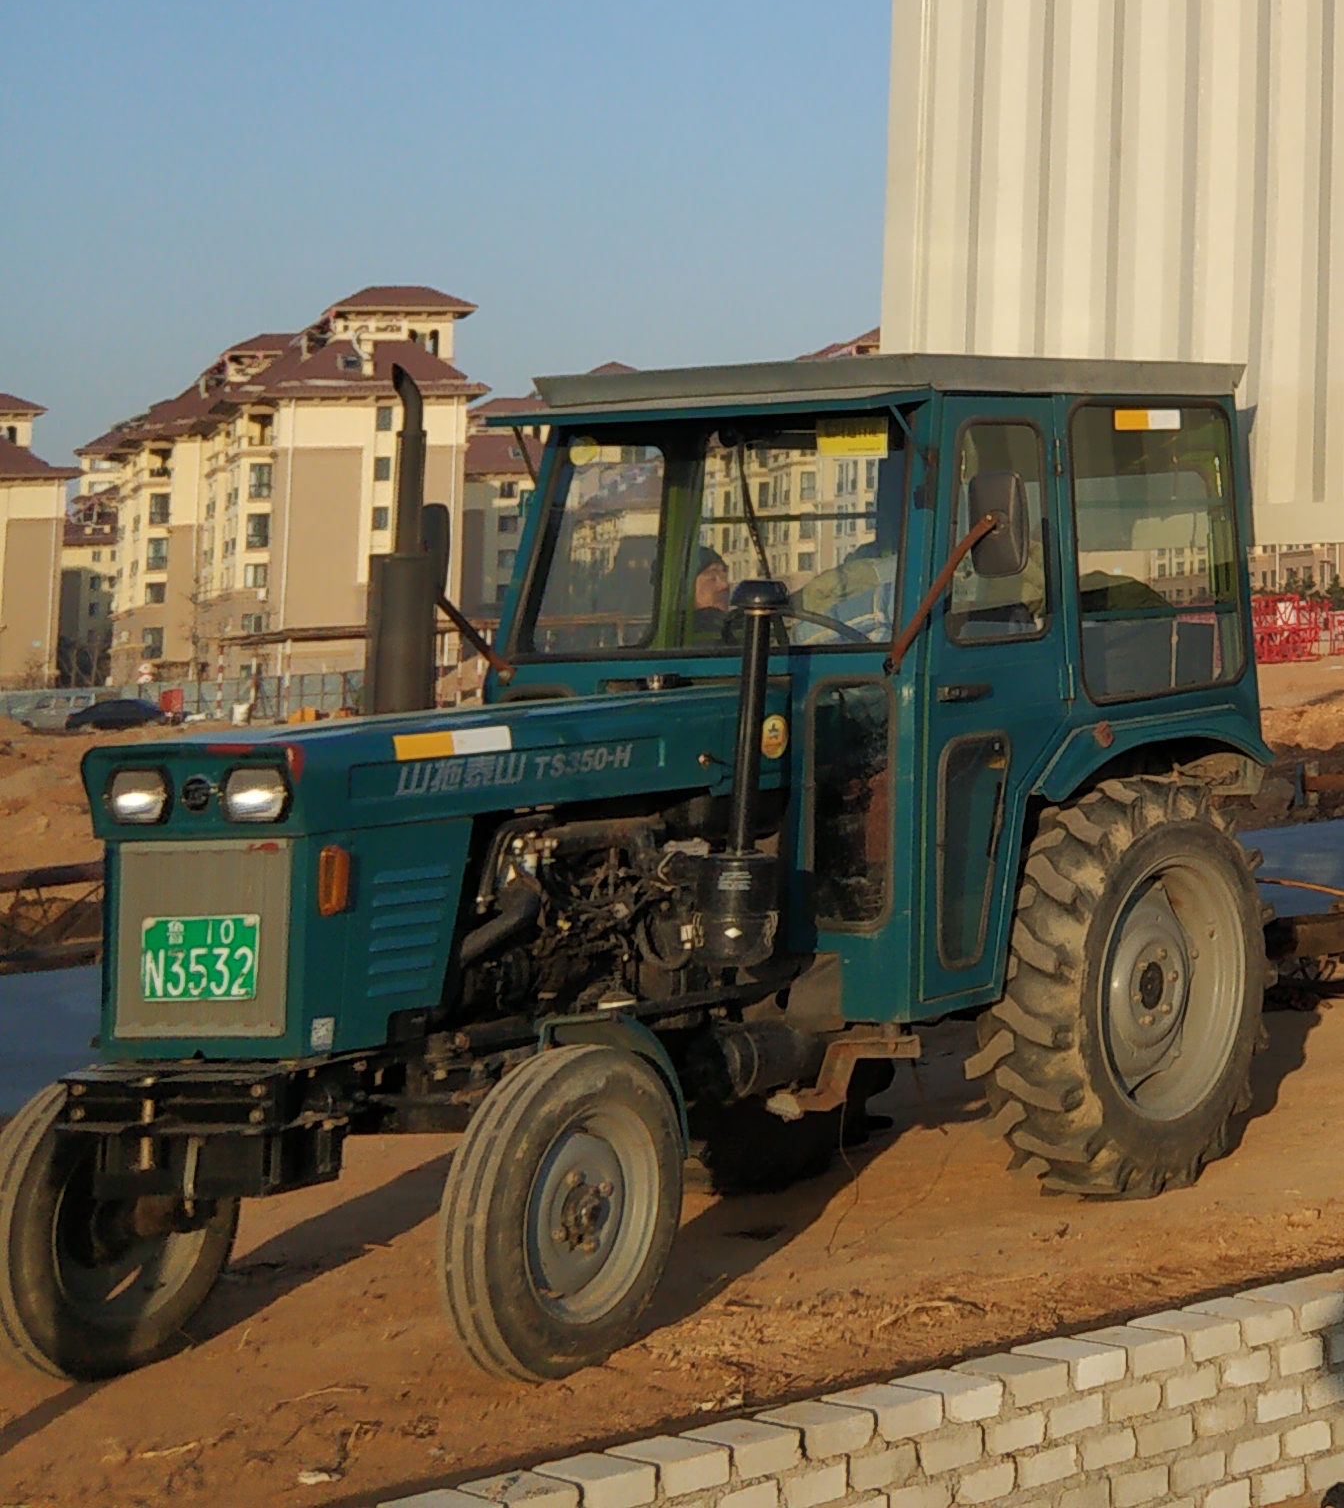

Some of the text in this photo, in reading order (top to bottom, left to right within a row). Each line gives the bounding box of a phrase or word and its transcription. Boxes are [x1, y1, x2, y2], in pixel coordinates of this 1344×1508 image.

[394, 743, 634, 797] 山拖泰山 TS350-H
[206, 919, 234, 945] 10
[145, 946, 253, 997] N3532
